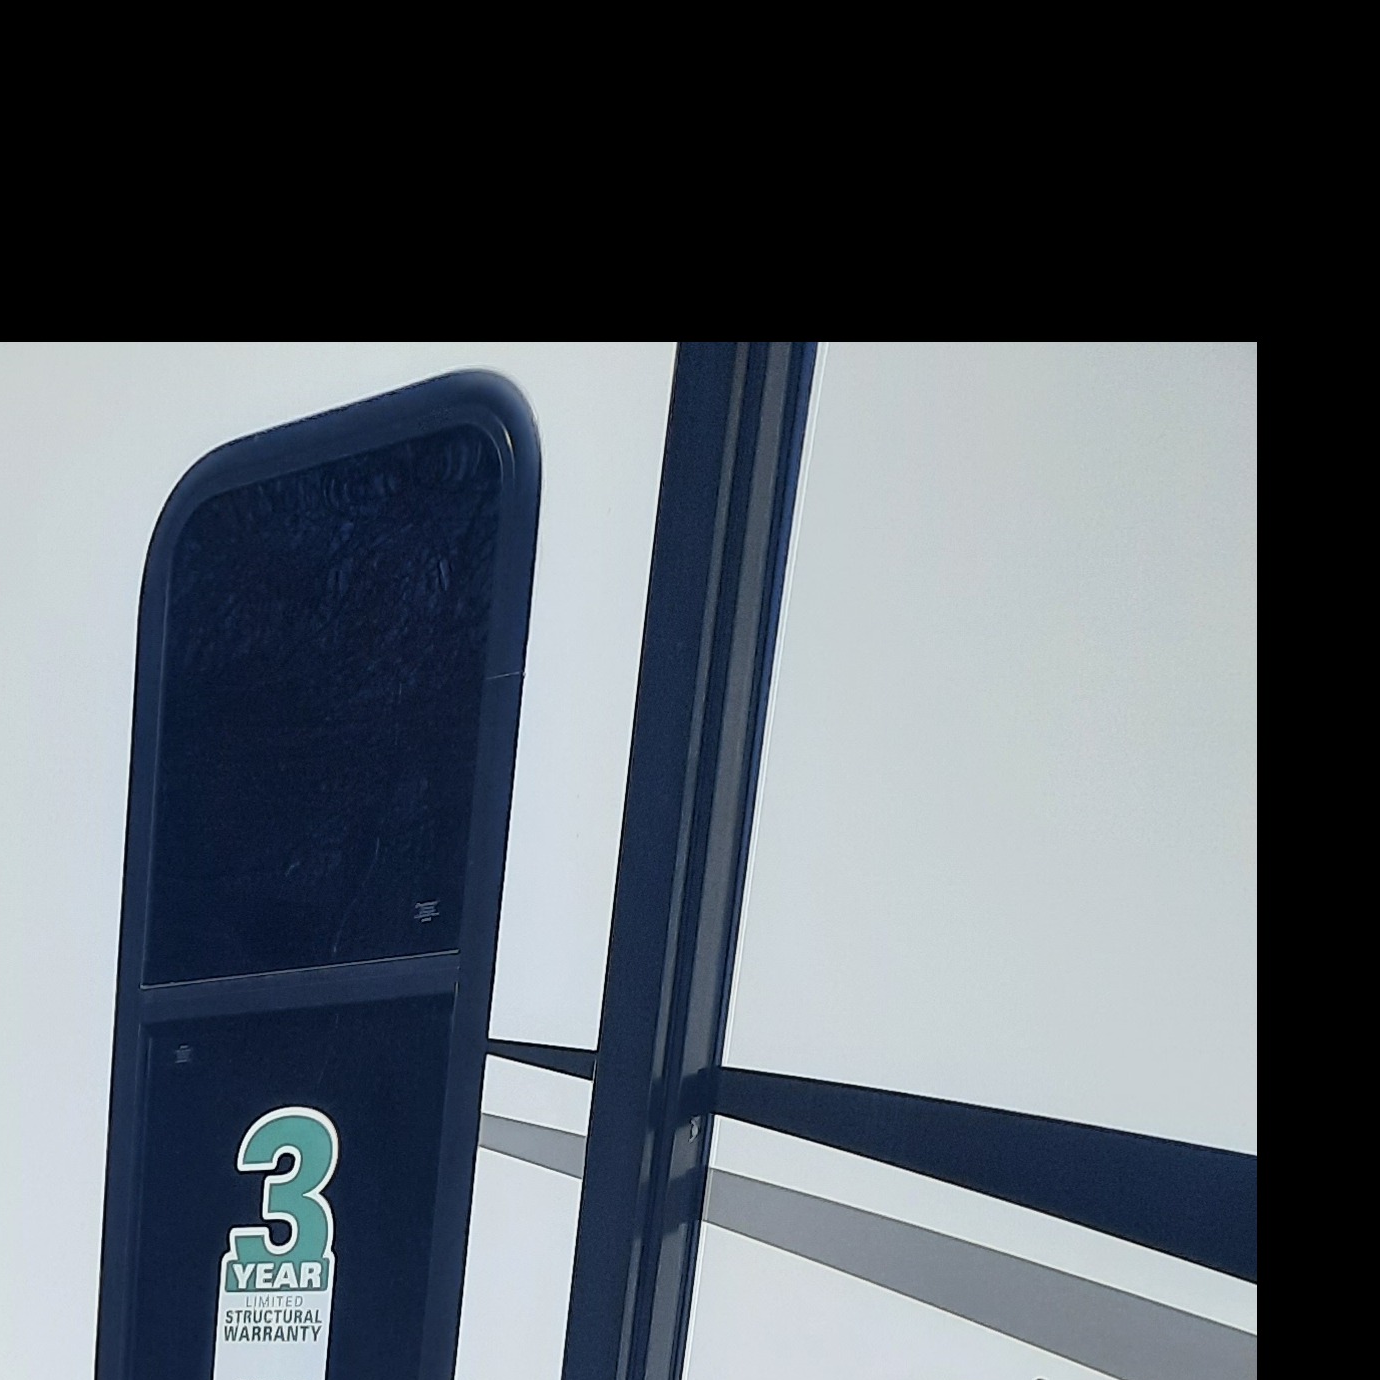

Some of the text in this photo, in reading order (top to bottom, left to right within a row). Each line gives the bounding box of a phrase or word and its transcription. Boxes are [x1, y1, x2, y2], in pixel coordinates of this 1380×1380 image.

[231, 1107, 338, 1260] 3
[232, 1262, 322, 1289] YEAR
[245, 1295, 304, 1308] LIMITED
[225, 1309, 322, 1324] STRUCTURAL
[224, 1325, 322, 1342] WARRANTY
